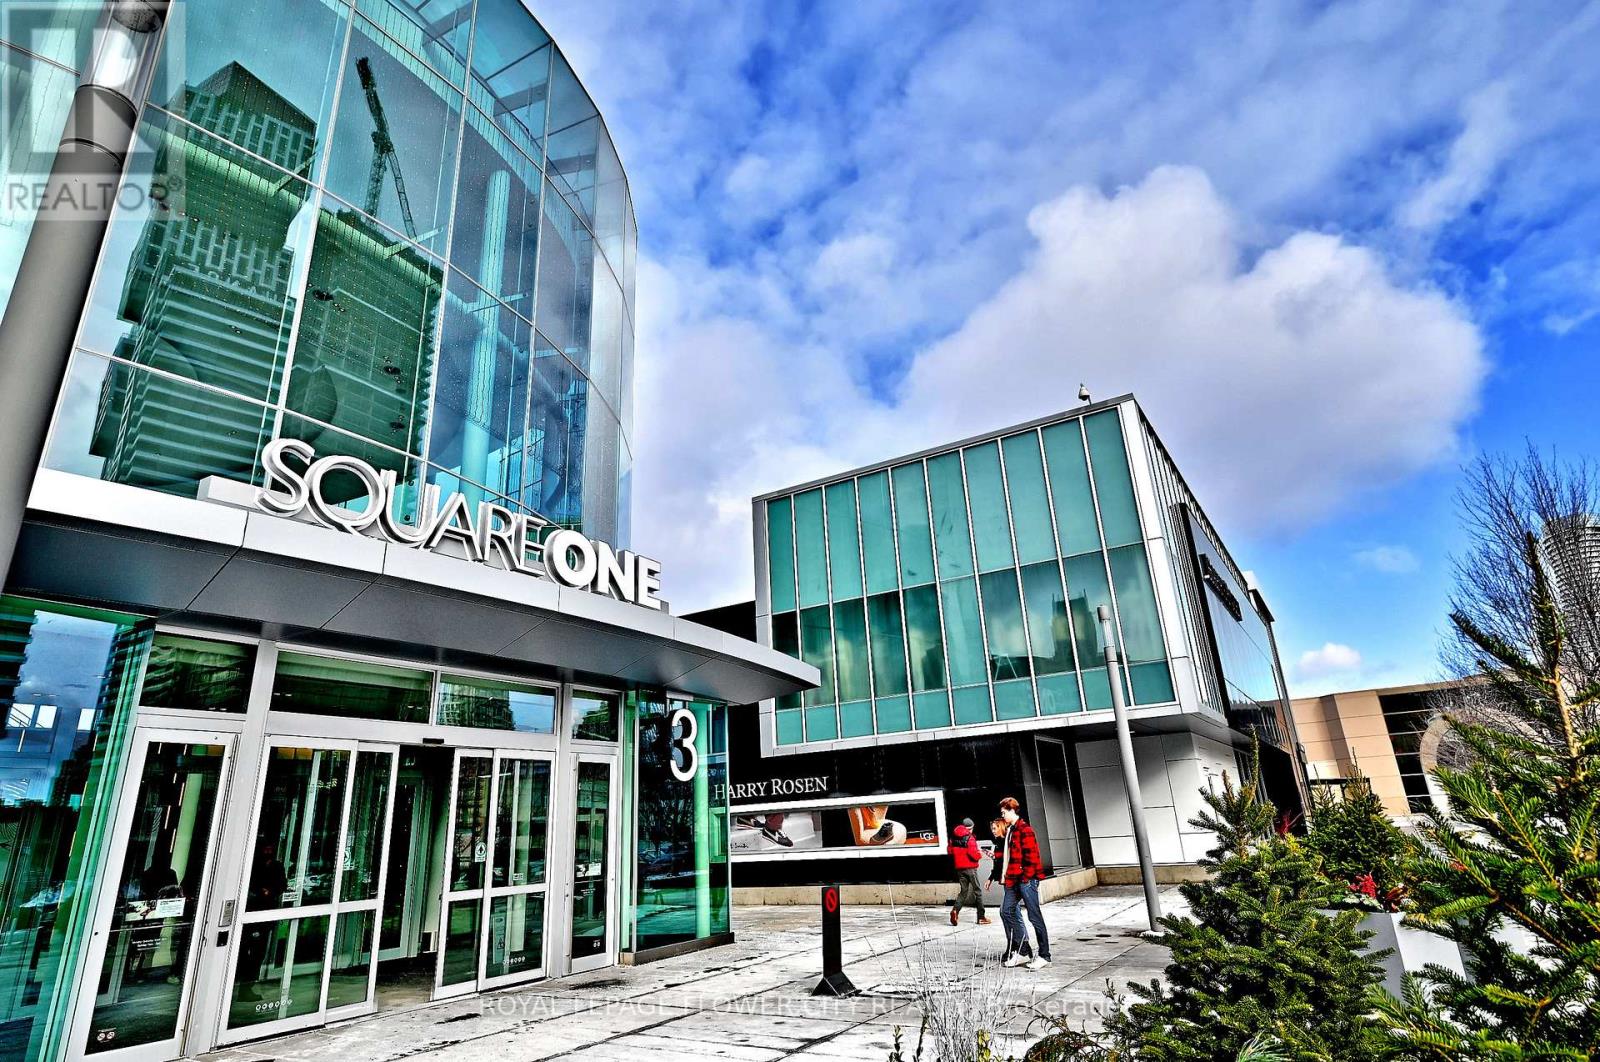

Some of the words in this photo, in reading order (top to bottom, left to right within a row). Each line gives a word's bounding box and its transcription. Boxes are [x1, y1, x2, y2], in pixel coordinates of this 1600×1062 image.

[669, 708, 698, 782] 3
[714, 782, 768, 800] HARRY
[770, 776, 830, 796] ROSEN
